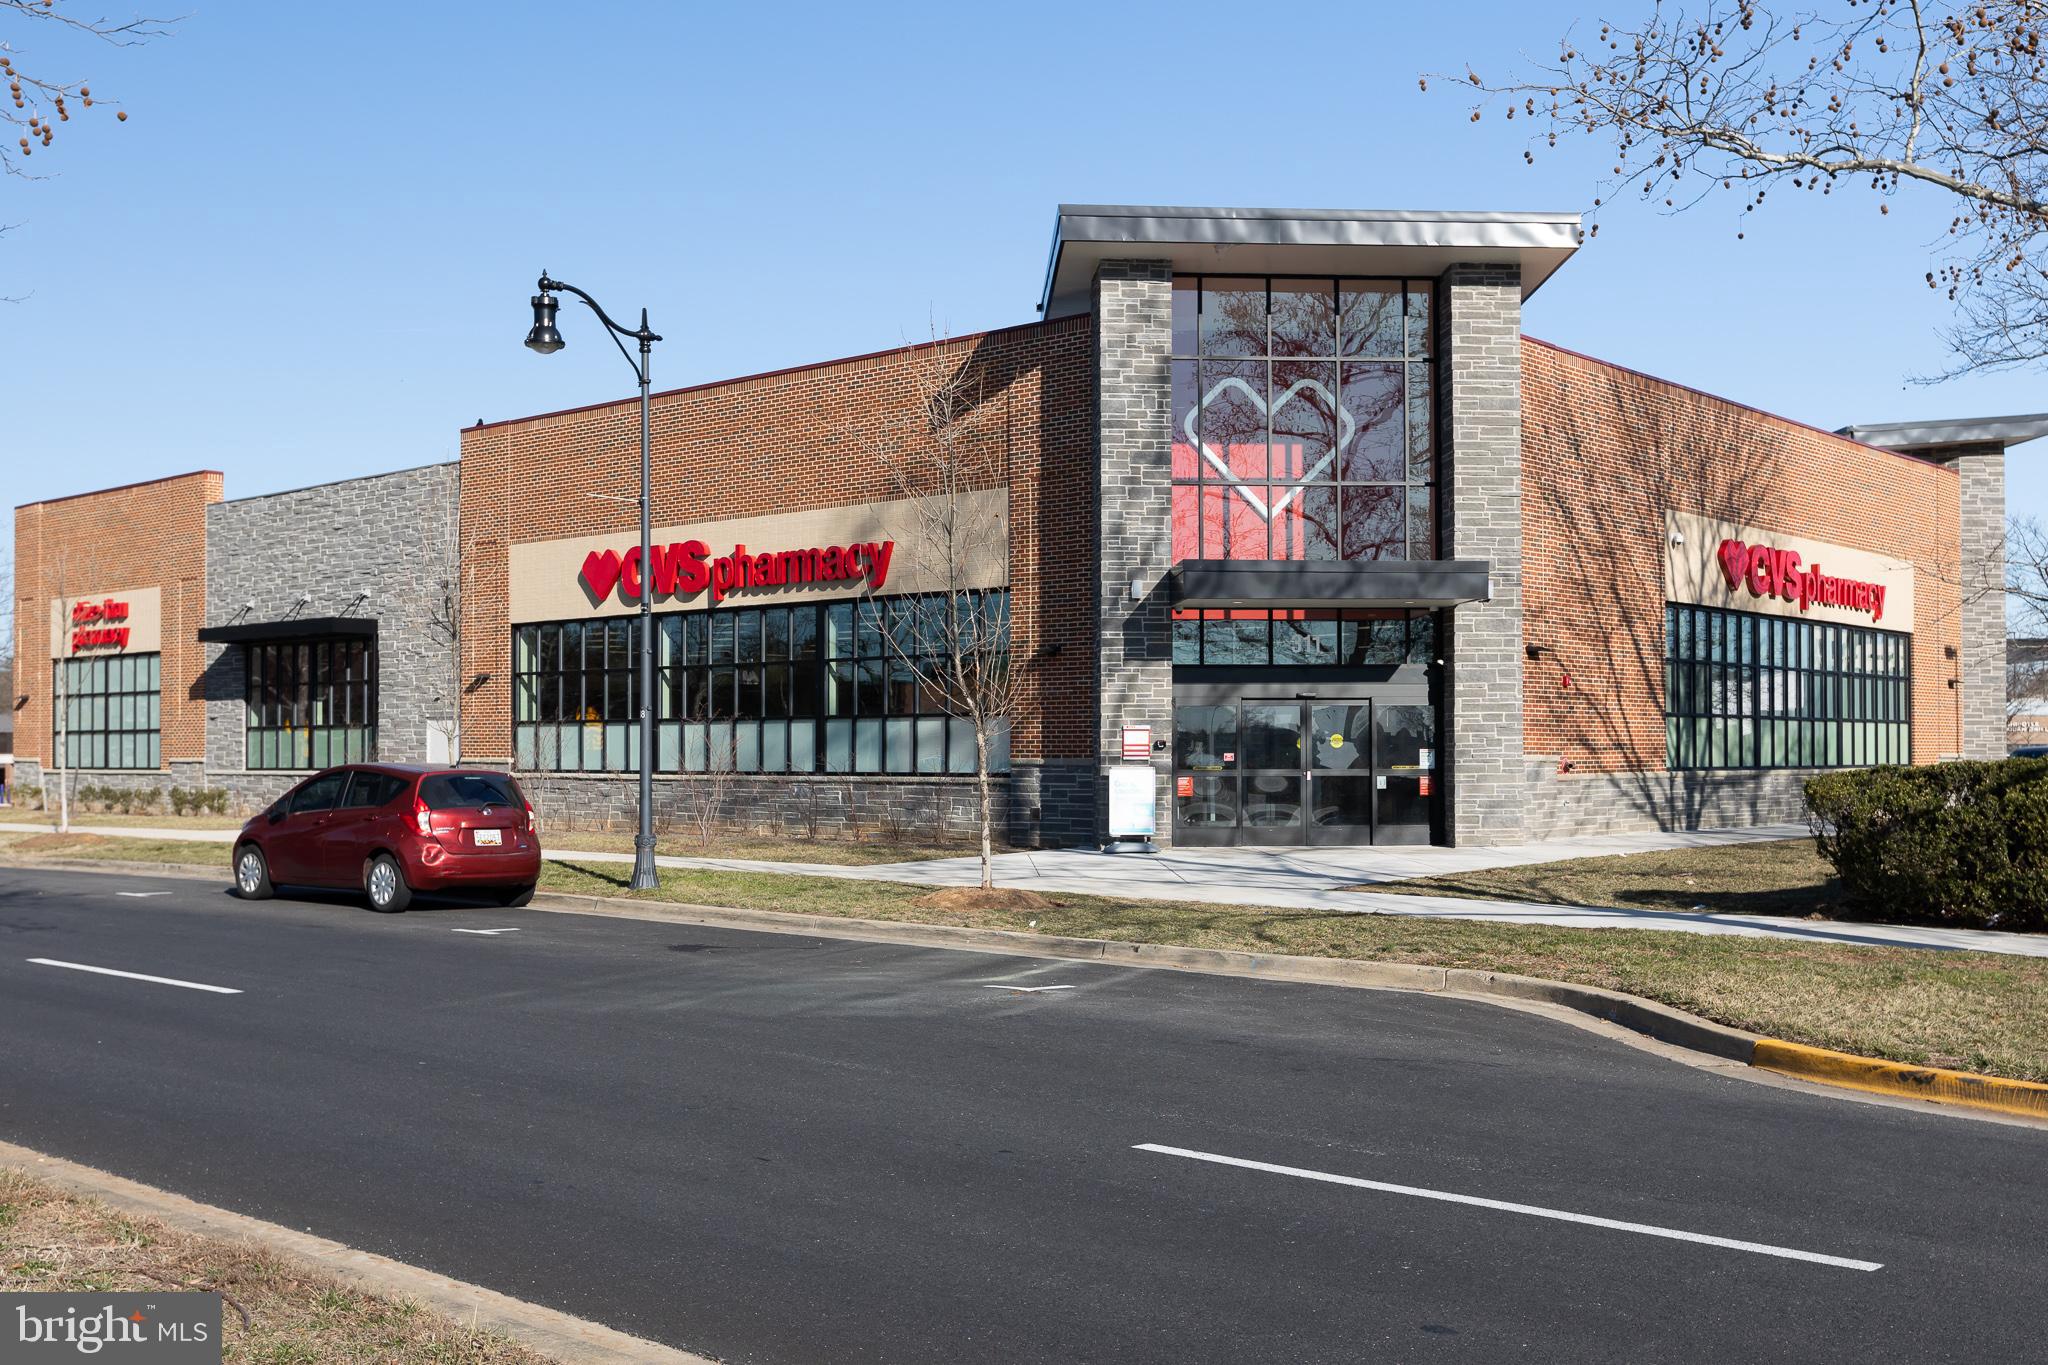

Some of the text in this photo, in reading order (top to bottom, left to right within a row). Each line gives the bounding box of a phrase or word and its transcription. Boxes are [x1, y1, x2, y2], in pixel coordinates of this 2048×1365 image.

[621, 540, 895, 601] CVS pharmacy
[1747, 544, 1886, 621] CVS pharmacy
